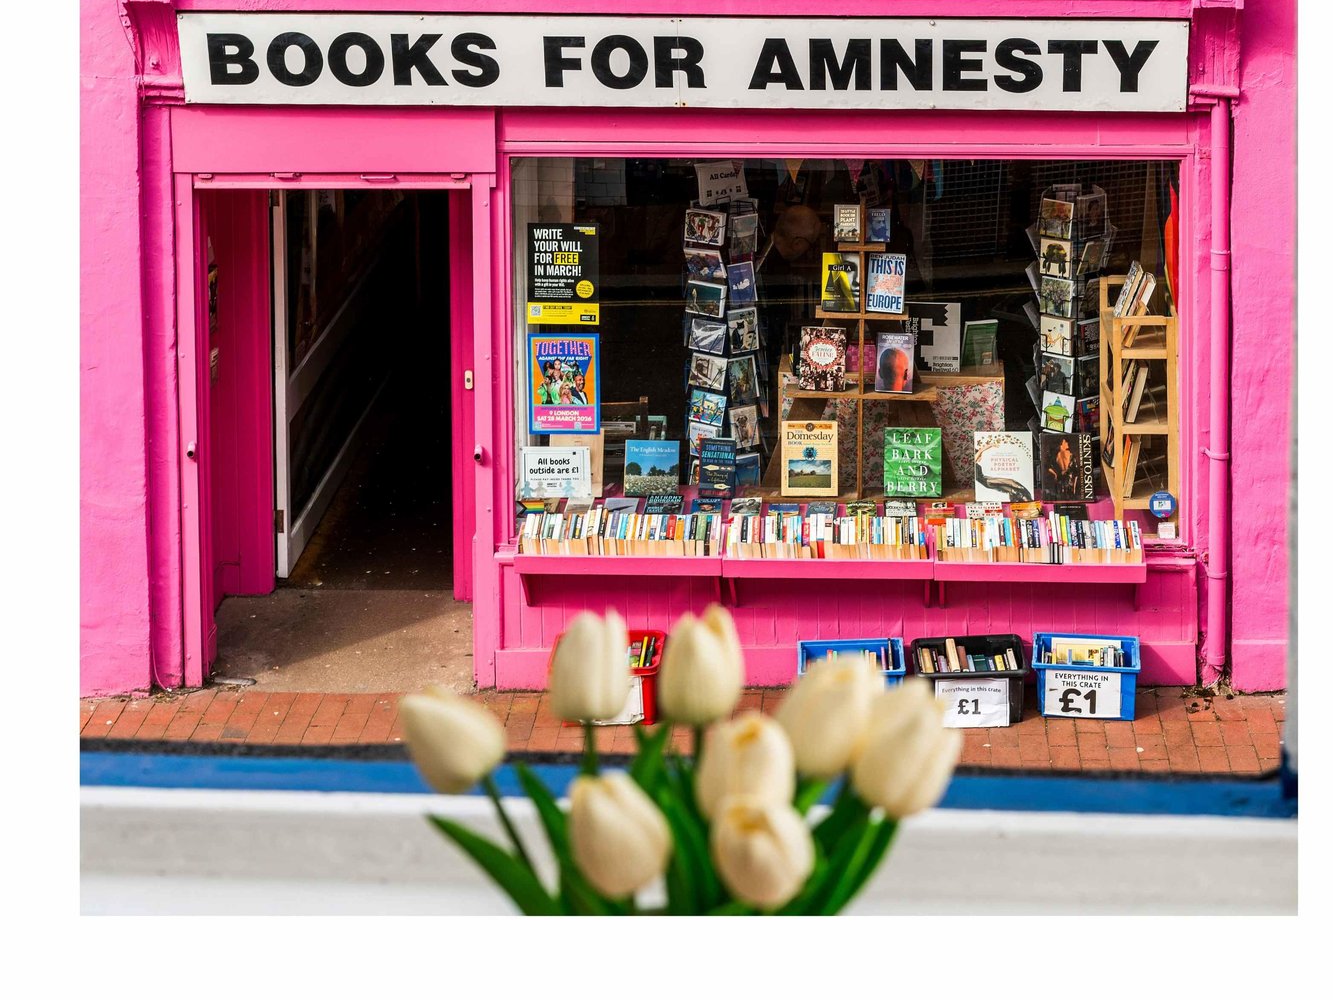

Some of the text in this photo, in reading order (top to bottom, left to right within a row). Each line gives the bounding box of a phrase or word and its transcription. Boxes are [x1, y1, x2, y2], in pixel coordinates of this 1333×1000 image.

[206, 31, 1159, 93] BOOKS FOR AMNESTY
[534, 228, 563, 240] WRITE
[534, 241, 582, 252] YOUR WILL
[534, 253, 578, 264] FOR FREE
[534, 265, 582, 276] IN MARCH!
[870, 259, 904, 275] THIS IS
[867, 294, 902, 310] EUROPE
[536, 340, 592, 356] TOGETHER
[786, 431, 834, 442] Domesday
[893, 433, 932, 444] LEAF
[702, 451, 735, 459] SENSATIONAL
[892, 450, 932, 459] BARK
[898, 466, 928, 476] AND
[1082, 434, 1093, 499] SKIN TO SKIN
[887, 482, 938, 492] BERRY
[1055, 673, 1098, 681] EVERYTHING
[958, 699, 981, 714] £1
[1059, 688, 1096, 714] £1
